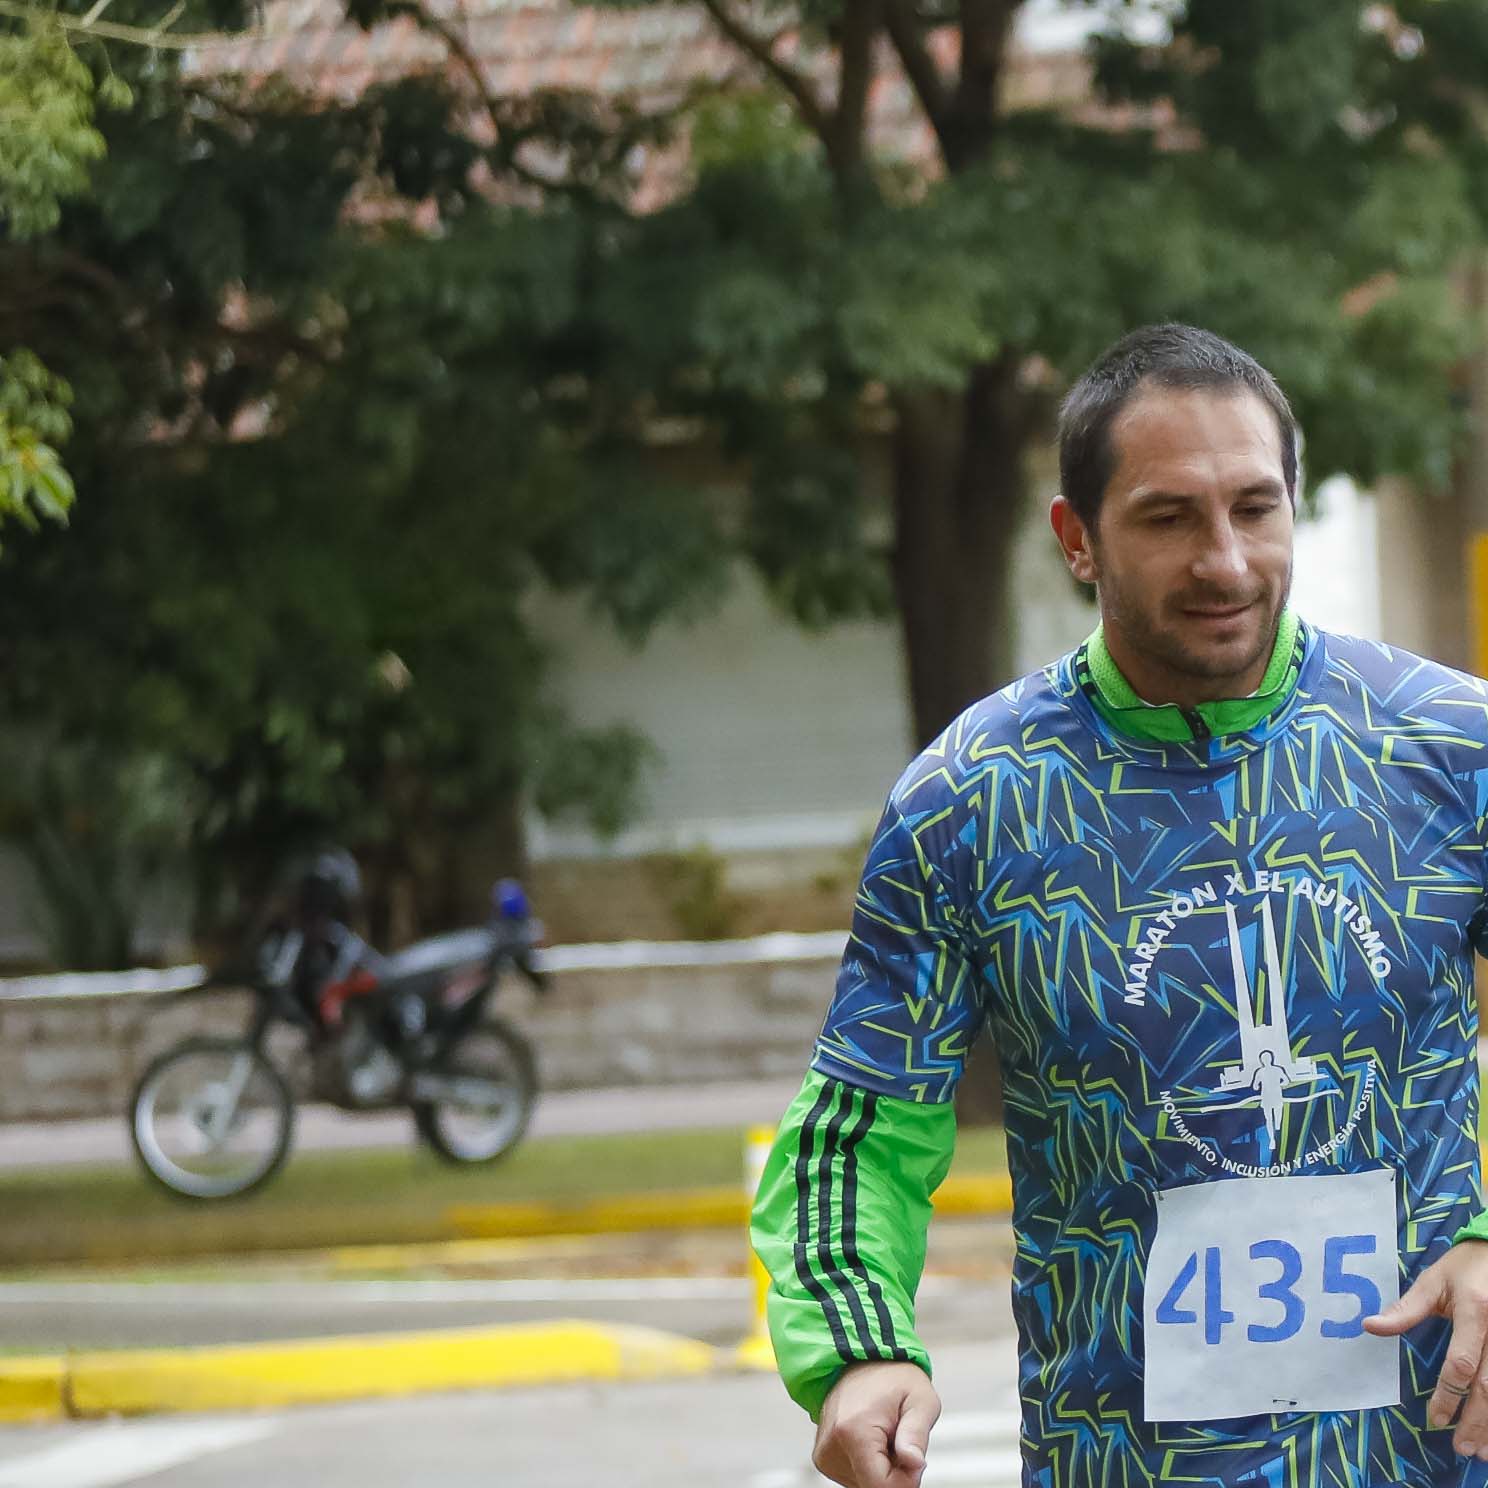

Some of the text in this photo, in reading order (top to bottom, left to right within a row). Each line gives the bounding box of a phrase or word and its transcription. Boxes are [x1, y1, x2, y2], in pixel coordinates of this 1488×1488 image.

[1255, 870, 1285, 893] EL
[1293, 876, 1392, 979] AUTISMO
[1353, 1059, 1377, 1121] POSITIVA
[1156, 1234, 1382, 1345] 435
